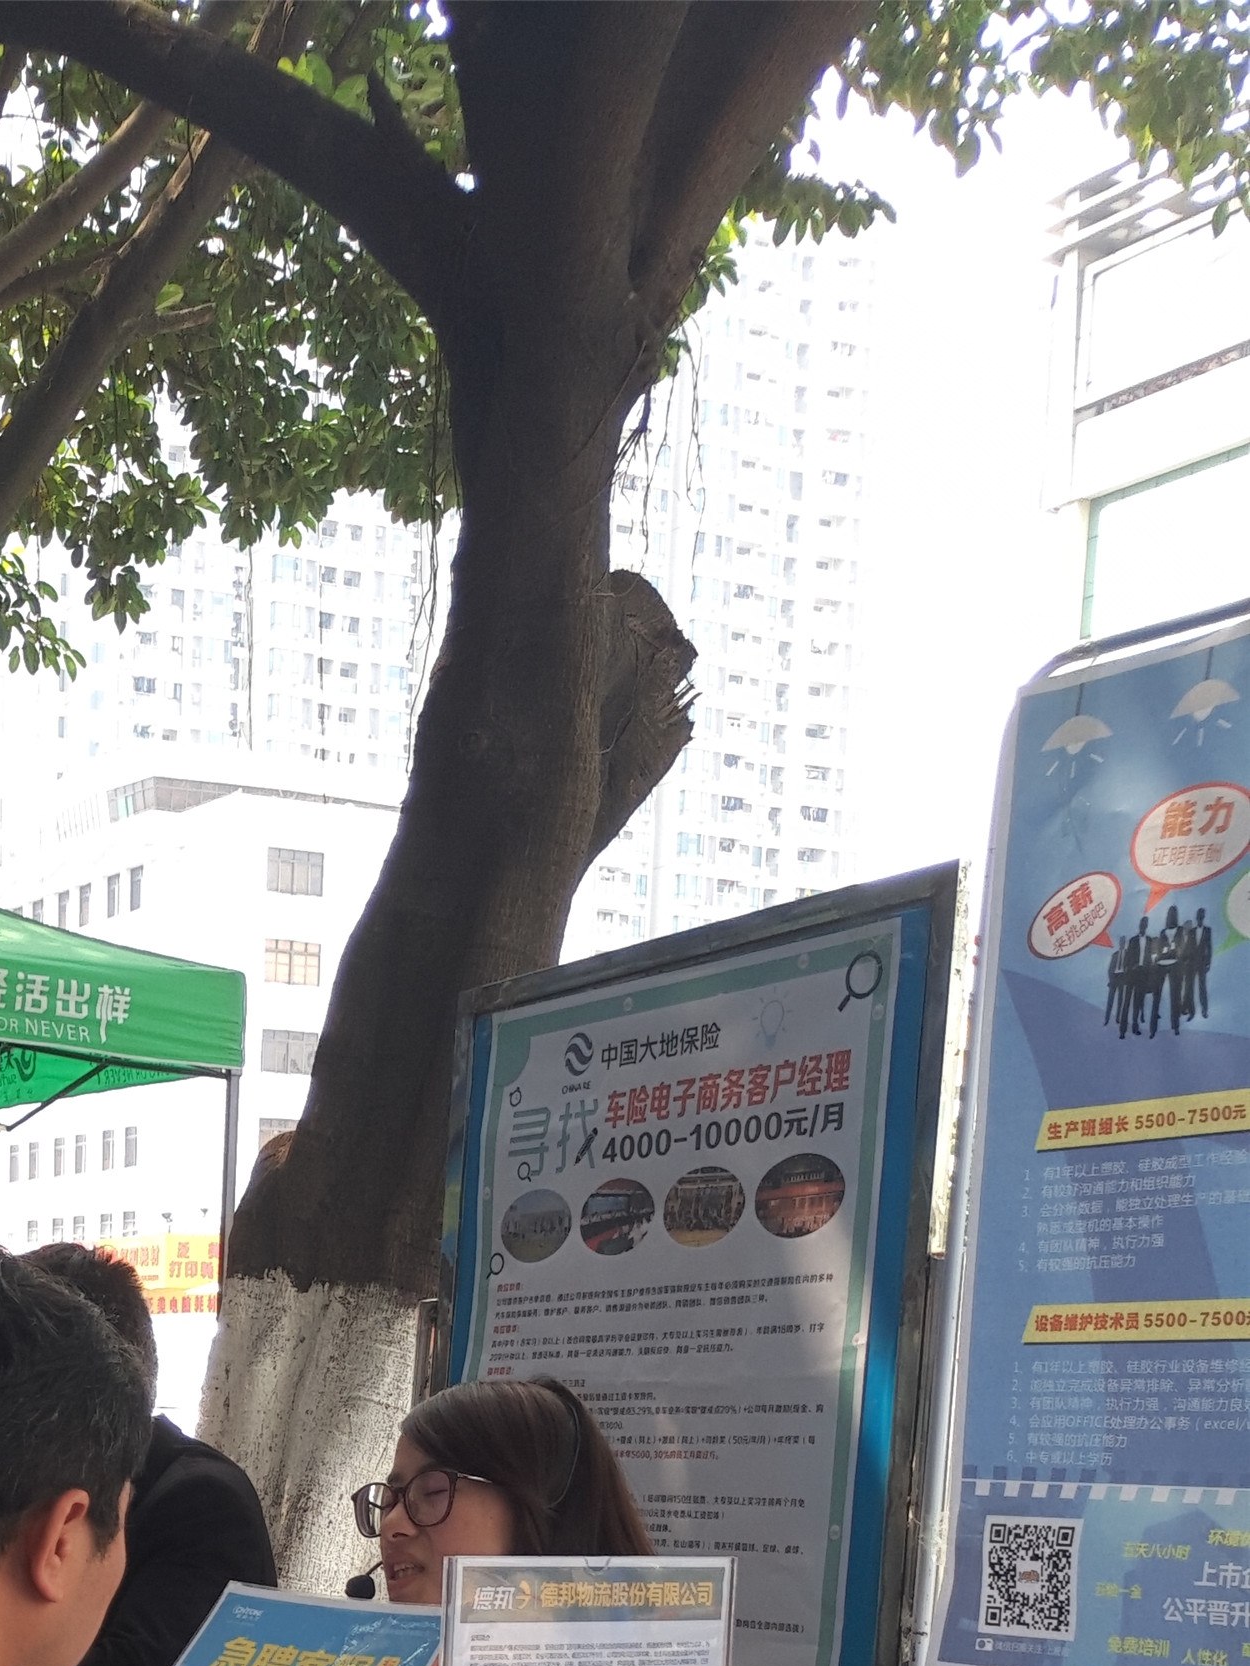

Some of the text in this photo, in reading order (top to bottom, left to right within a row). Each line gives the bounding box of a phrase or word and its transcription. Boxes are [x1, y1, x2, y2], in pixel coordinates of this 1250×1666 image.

[1160, 796, 1236, 840] 能力
[1043, 880, 1094, 936] 高薪
[1052, 901, 1108, 956] 来挑战吧
[25, 1018, 91, 1043] NEVER
[601, 1022, 721, 1071] 中国大地保险
[605, 1049, 852, 1129] 车险电子商务客户经理
[508, 1099, 599, 1177] 寻找
[602, 1101, 845, 1163] 4000-10000元/月
[1047, 1104, 1247, 1141] 生产班组长 5500-7500元
[1034, 1310, 1250, 1333] 设备维护技术员 5500-7500
[471, 1580, 714, 1612] 德邦 德邦物流股份有限公司
[1162, 1596, 1250, 1629] 公平晋升
